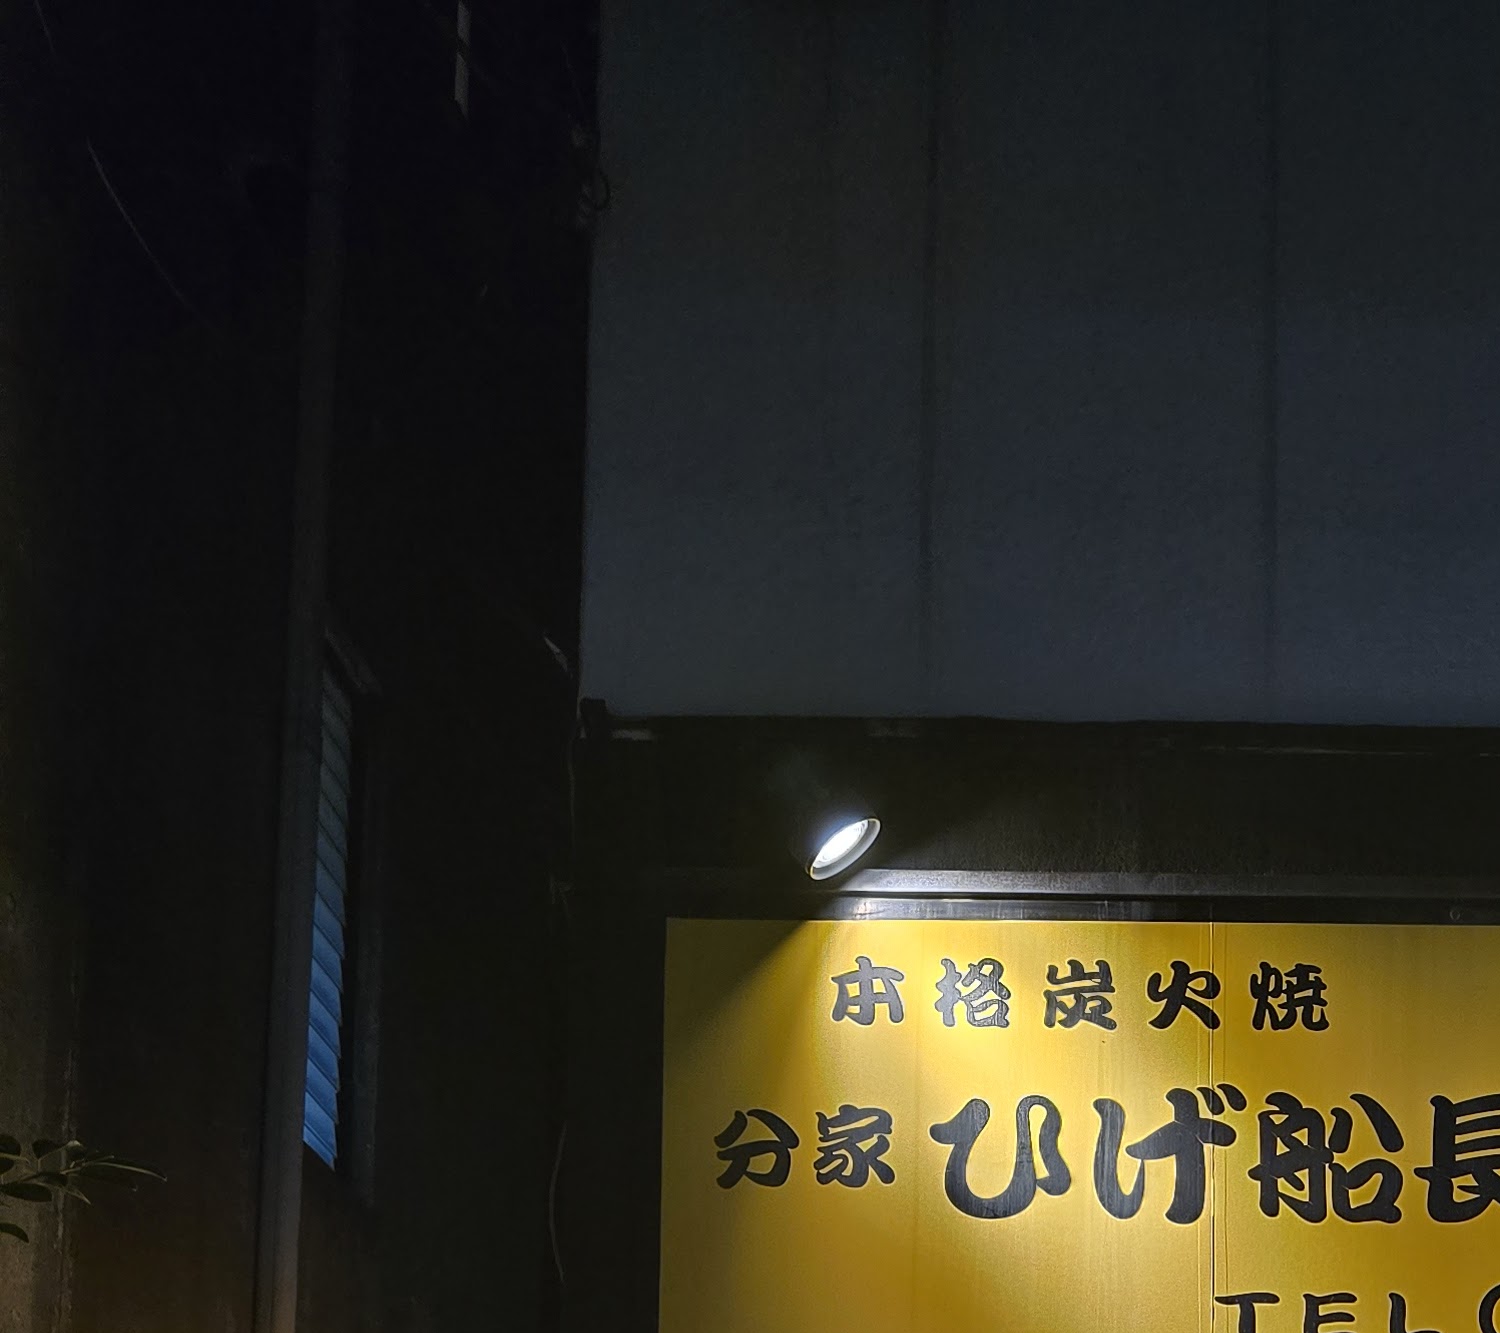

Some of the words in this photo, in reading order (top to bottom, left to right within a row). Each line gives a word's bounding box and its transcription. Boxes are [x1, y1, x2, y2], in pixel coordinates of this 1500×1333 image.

[831, 955, 1330, 1031] 本格炭火焼
[712, 1104, 897, 1189] 分家
